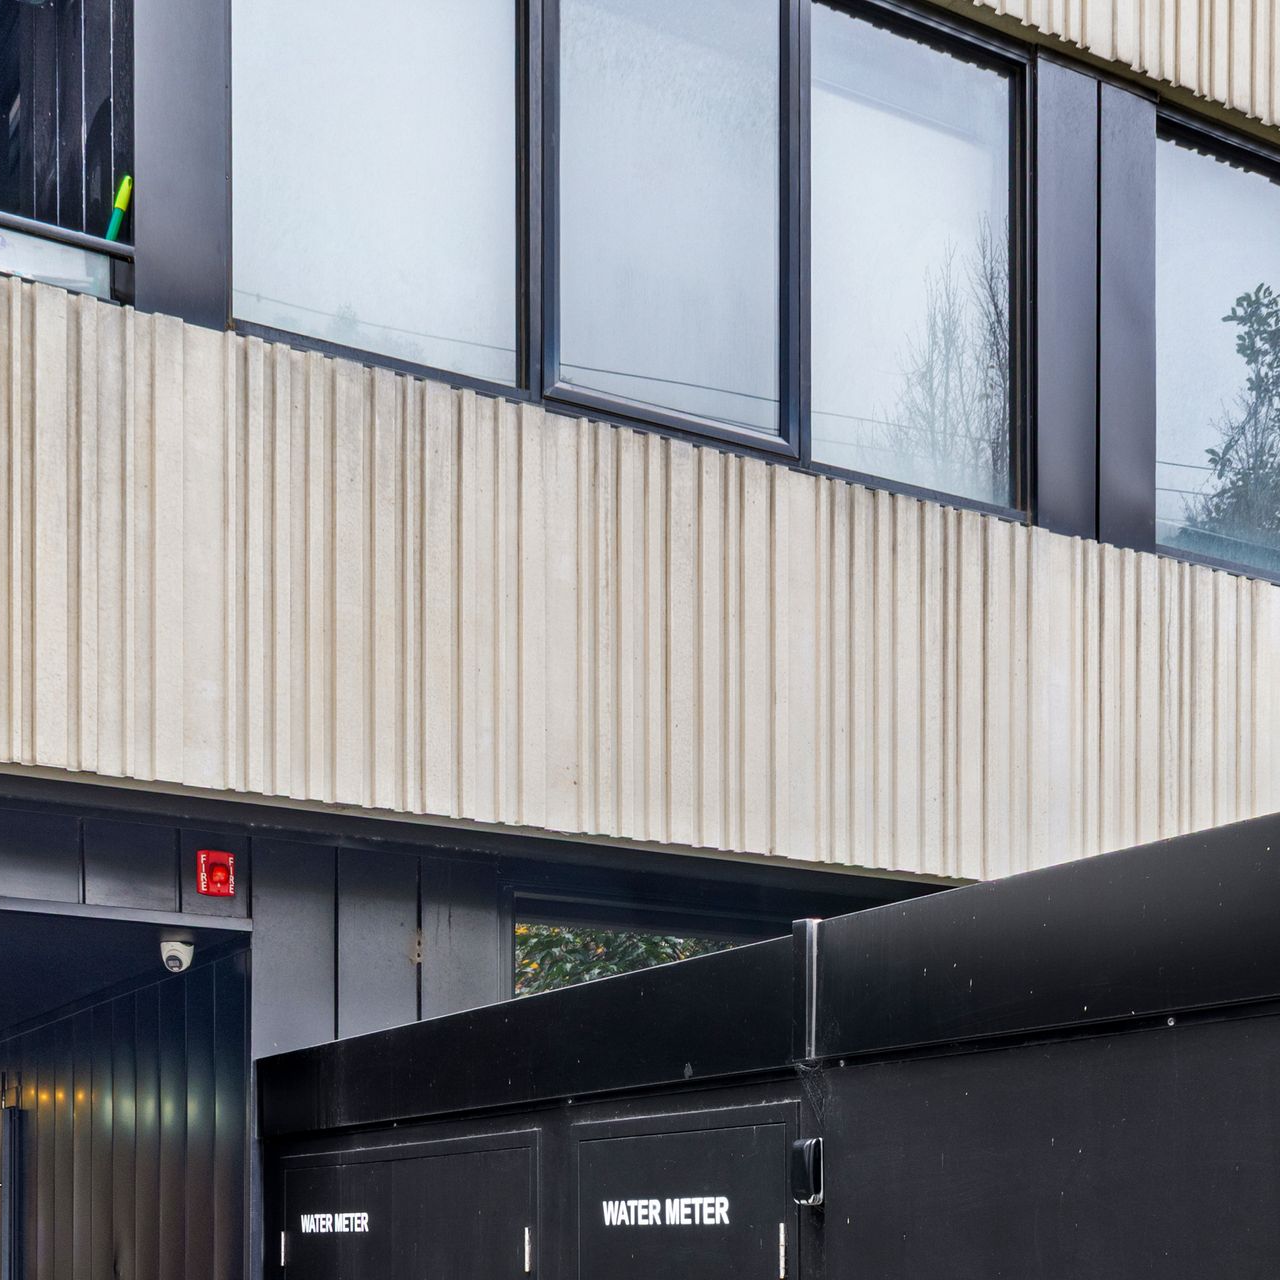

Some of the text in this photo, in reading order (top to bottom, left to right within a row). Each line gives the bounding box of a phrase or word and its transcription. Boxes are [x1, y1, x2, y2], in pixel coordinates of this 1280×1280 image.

[300, 1212, 370, 1234] WATER METER
[601, 1195, 730, 1227] WATER METER
